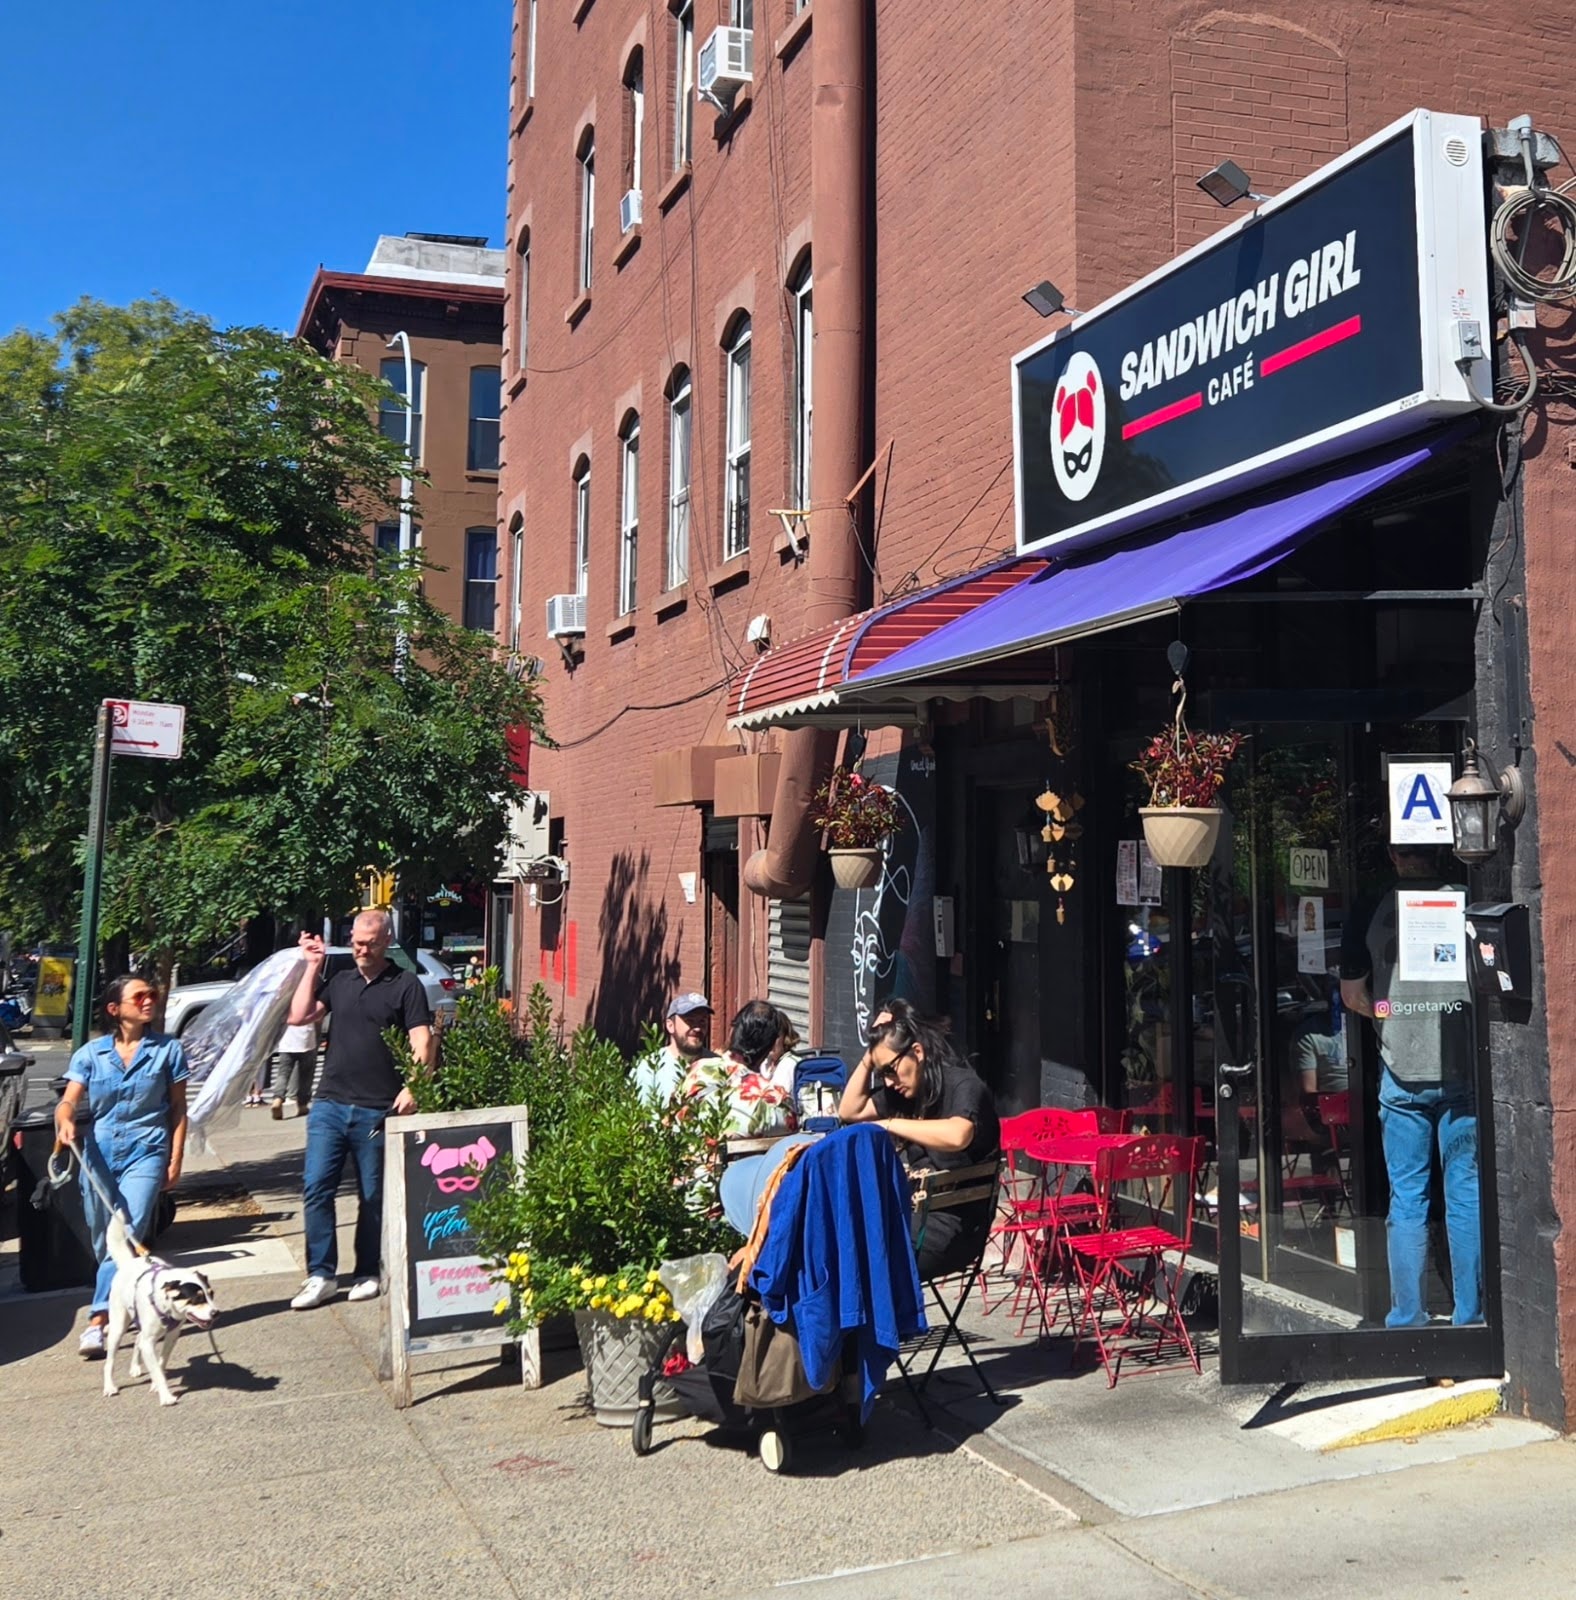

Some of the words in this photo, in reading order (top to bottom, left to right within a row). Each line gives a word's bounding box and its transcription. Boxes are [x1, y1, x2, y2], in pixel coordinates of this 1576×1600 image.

[1119, 273, 1279, 400] SANDWICH
[1283, 229, 1361, 318] GIRL
[1208, 352, 1254, 406] CAFÉ
[1401, 774, 1442, 819] A
[1292, 854, 1326, 881] OPEN
[1390, 1001, 1462, 1016] @gretanyc
[423, 1205, 460, 1238] yes
